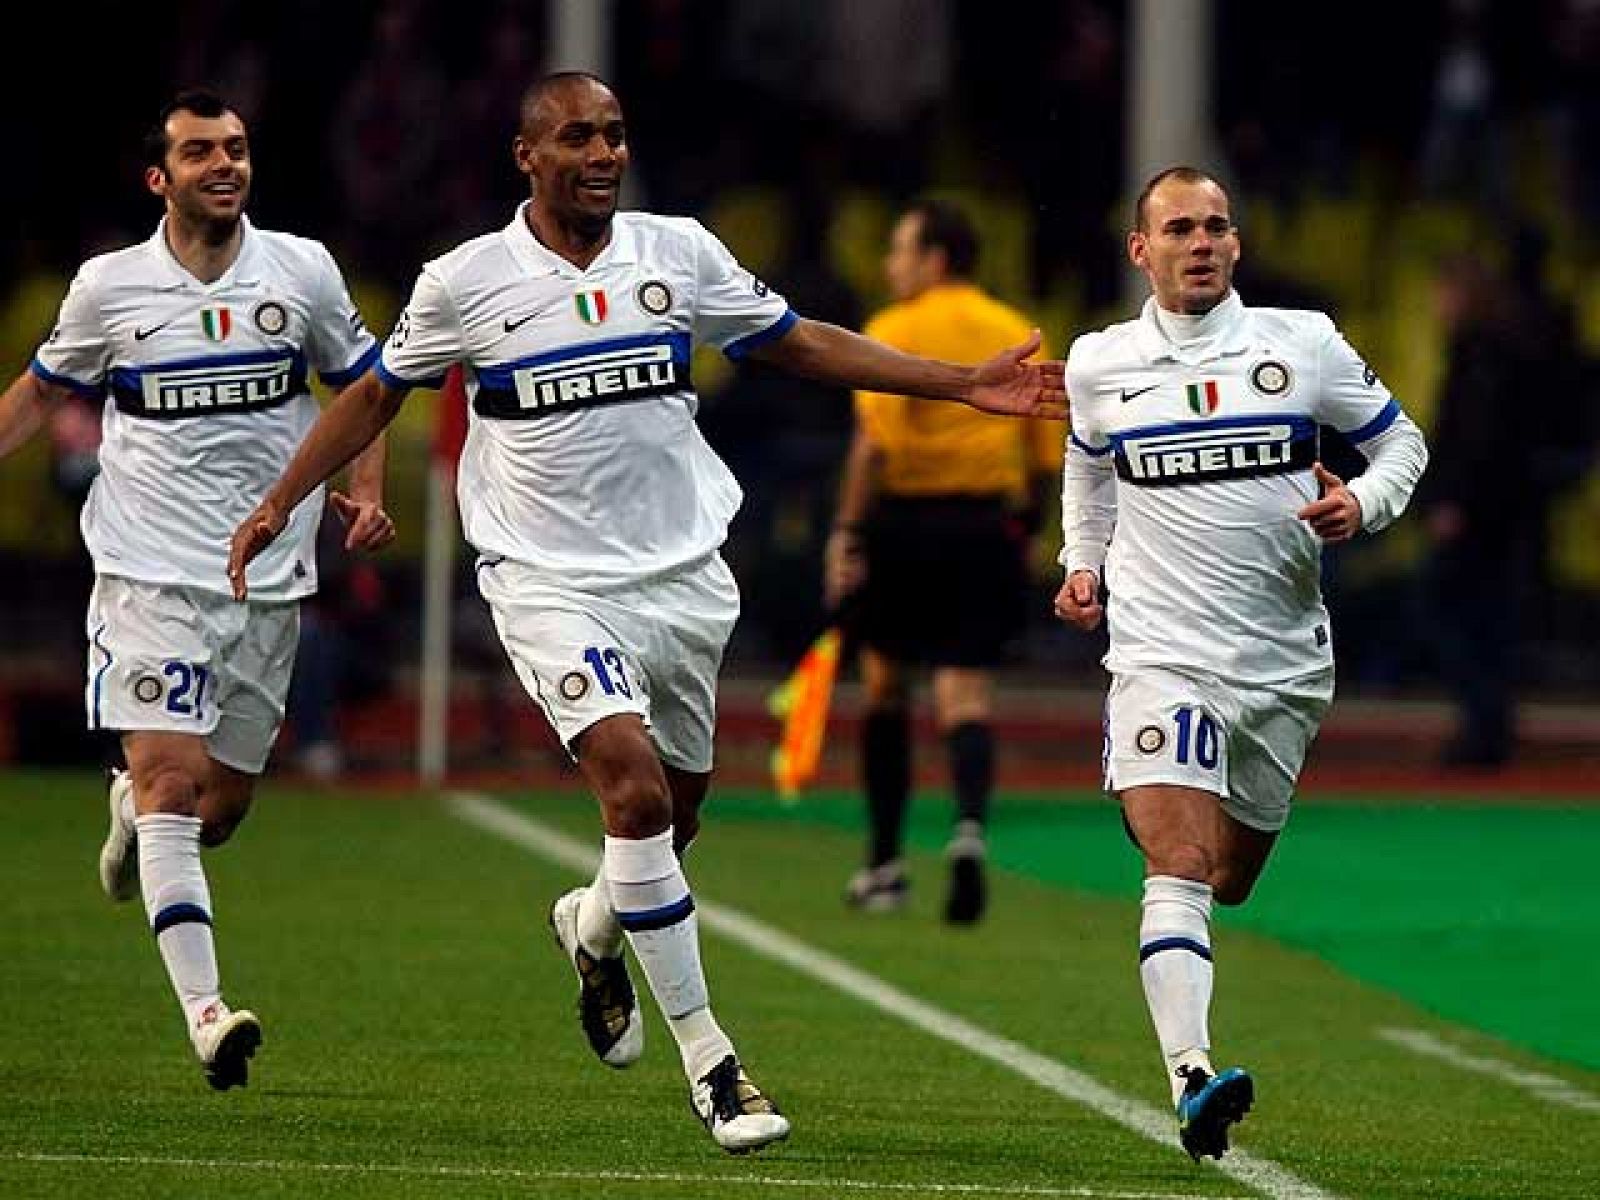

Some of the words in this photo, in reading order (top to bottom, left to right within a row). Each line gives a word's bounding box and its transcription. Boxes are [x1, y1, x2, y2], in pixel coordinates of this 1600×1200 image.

[142, 357, 292, 410] PIRELLI
[514, 344, 675, 408] PIRELLI
[1123, 424, 1291, 478] PIRELLI
[584, 647, 633, 700] 13
[1173, 706, 1218, 770] 10
